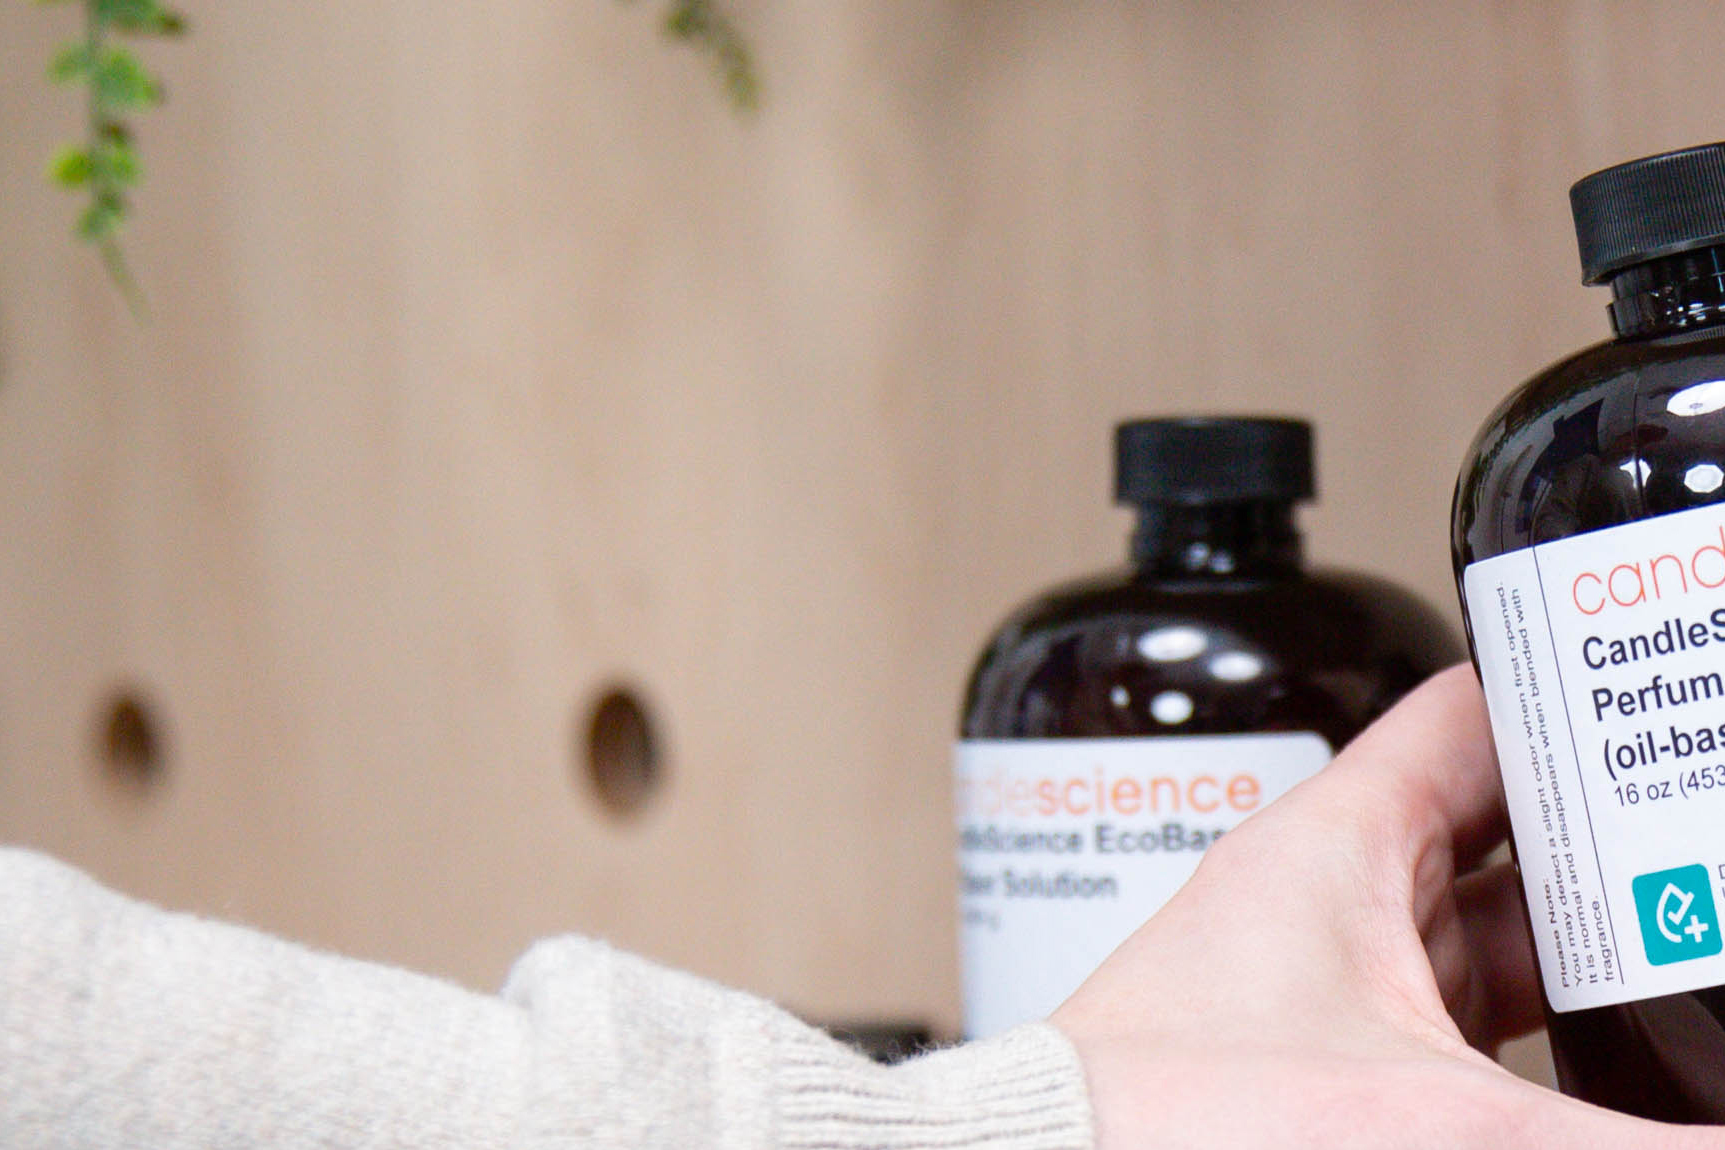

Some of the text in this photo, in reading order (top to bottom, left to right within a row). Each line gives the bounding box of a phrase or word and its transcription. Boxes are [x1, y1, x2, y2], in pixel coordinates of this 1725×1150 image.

[1496, 582, 1583, 987] You may detect a slight odor when first opened.
[1510, 588, 1599, 985] It is normal and disappears when blended with
[1614, 782, 1640, 807] 16
[1646, 781, 1673, 801] oz
[1553, 929, 1570, 988] Please
[1591, 895, 1615, 982] fragrance.
